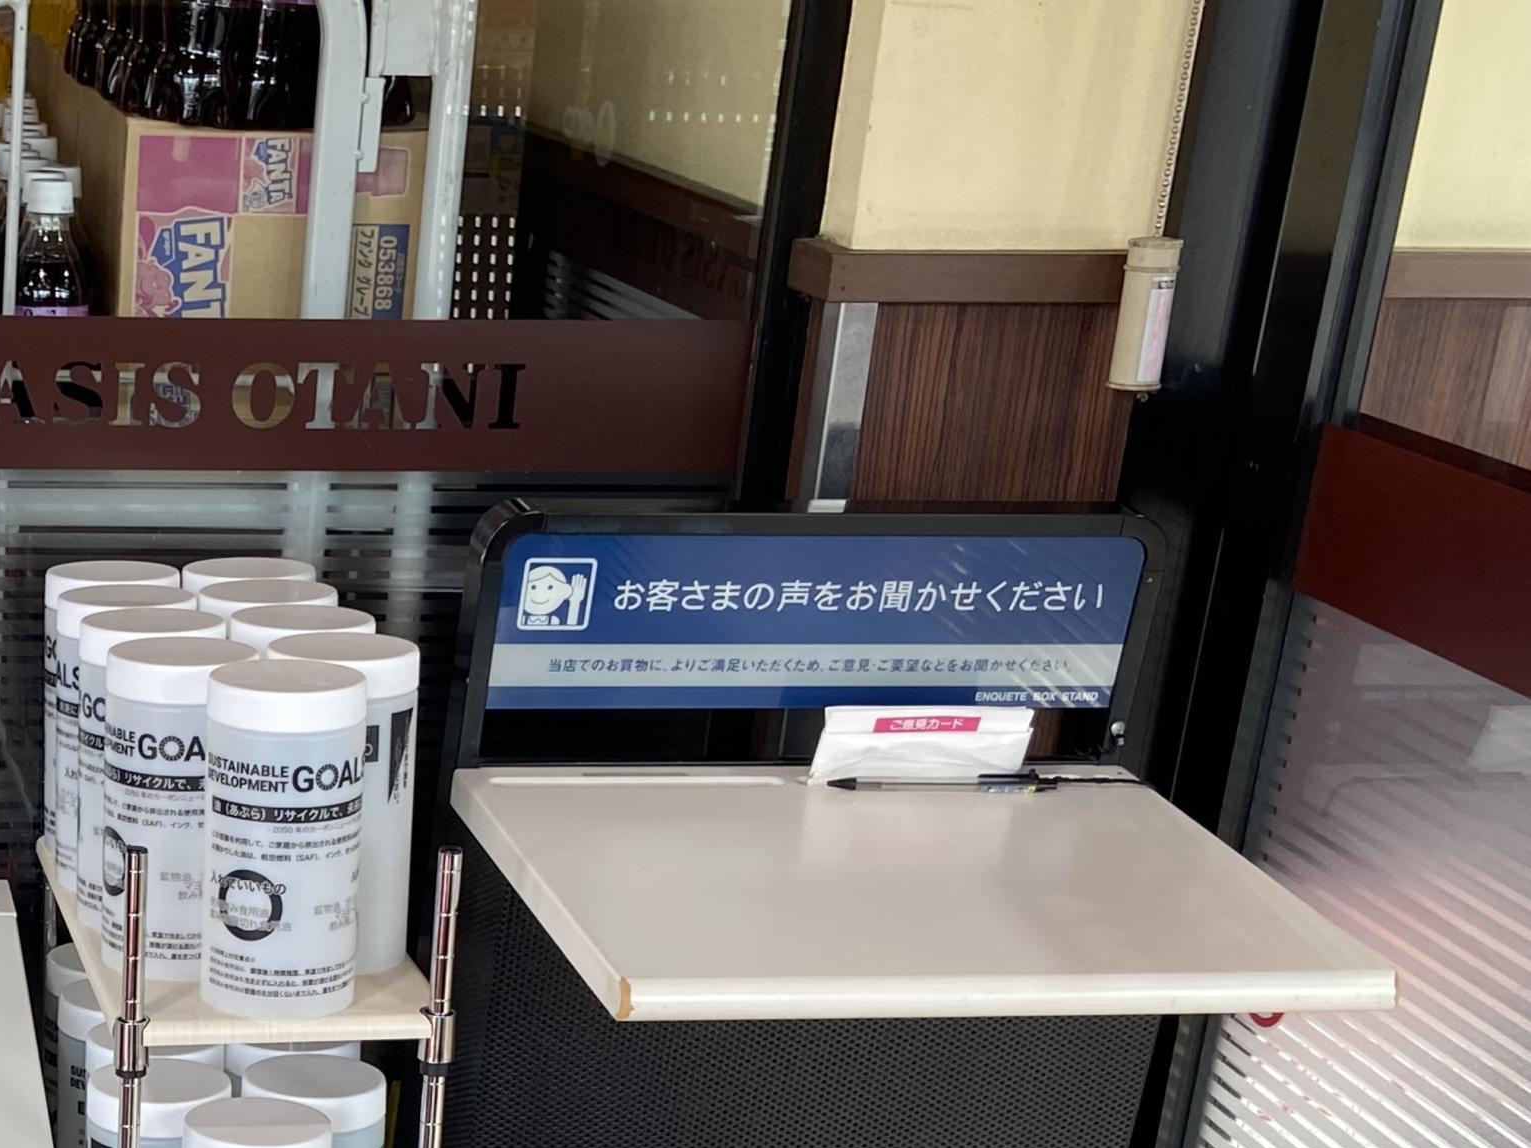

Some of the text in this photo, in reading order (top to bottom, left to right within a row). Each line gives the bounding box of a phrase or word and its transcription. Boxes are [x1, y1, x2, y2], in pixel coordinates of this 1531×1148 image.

[374, 235, 398, 311] 053868
[230, 361, 527, 429] OTANI
[613, 579, 1103, 613] お客さまの声をお聞かせください
[975, 691, 1100, 702] ENQUETE BOX STAND
[889, 718, 963, 731] ご意見カード
[208, 752, 289, 778] SUSTAINABLE
[208, 767, 289, 793] DEVELOPMENT
